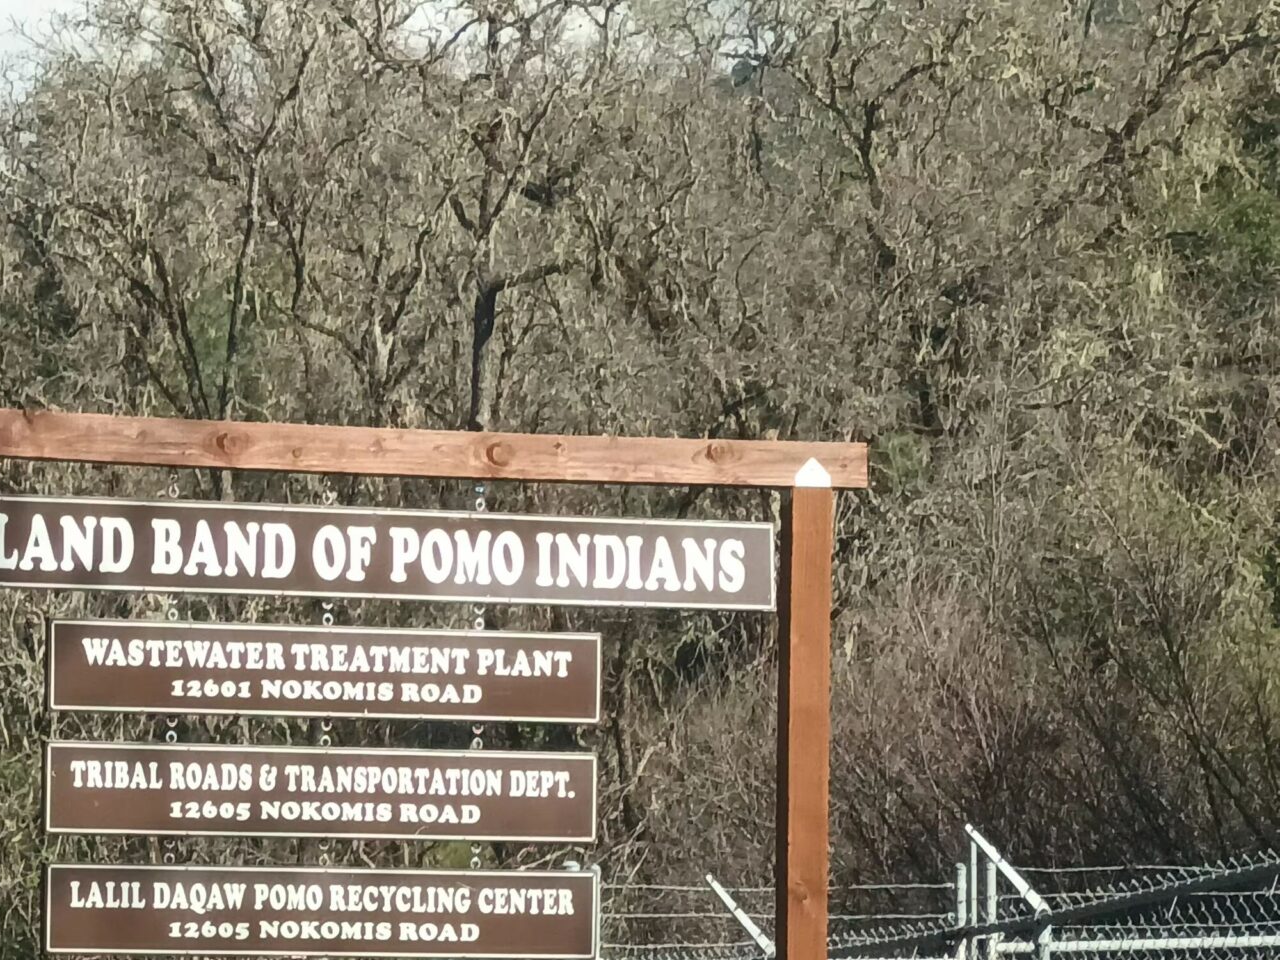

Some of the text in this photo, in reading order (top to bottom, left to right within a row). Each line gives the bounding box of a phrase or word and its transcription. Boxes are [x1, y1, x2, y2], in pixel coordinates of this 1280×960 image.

[150, 518, 296, 579] BAND
[312, 524, 377, 582] OF
[388, 526, 525, 586] POMO
[535, 532, 746, 593] INDIANS
[81, 637, 573, 678] WASTEWATER TREATMENT PLANT
[171, 678, 483, 704] 12601 NOKOMIS ROAD
[70, 760, 576, 799] TRIBAL ROADS & TRANSPORTATION DEPT.
[169, 800, 481, 824] 12605 NOKOMIS ROAD
[69, 880, 575, 915] LALIL DAQAW POMO RECYCLING CENTER
[168, 920, 480, 942] 12605 NOKOMIS ROAD
